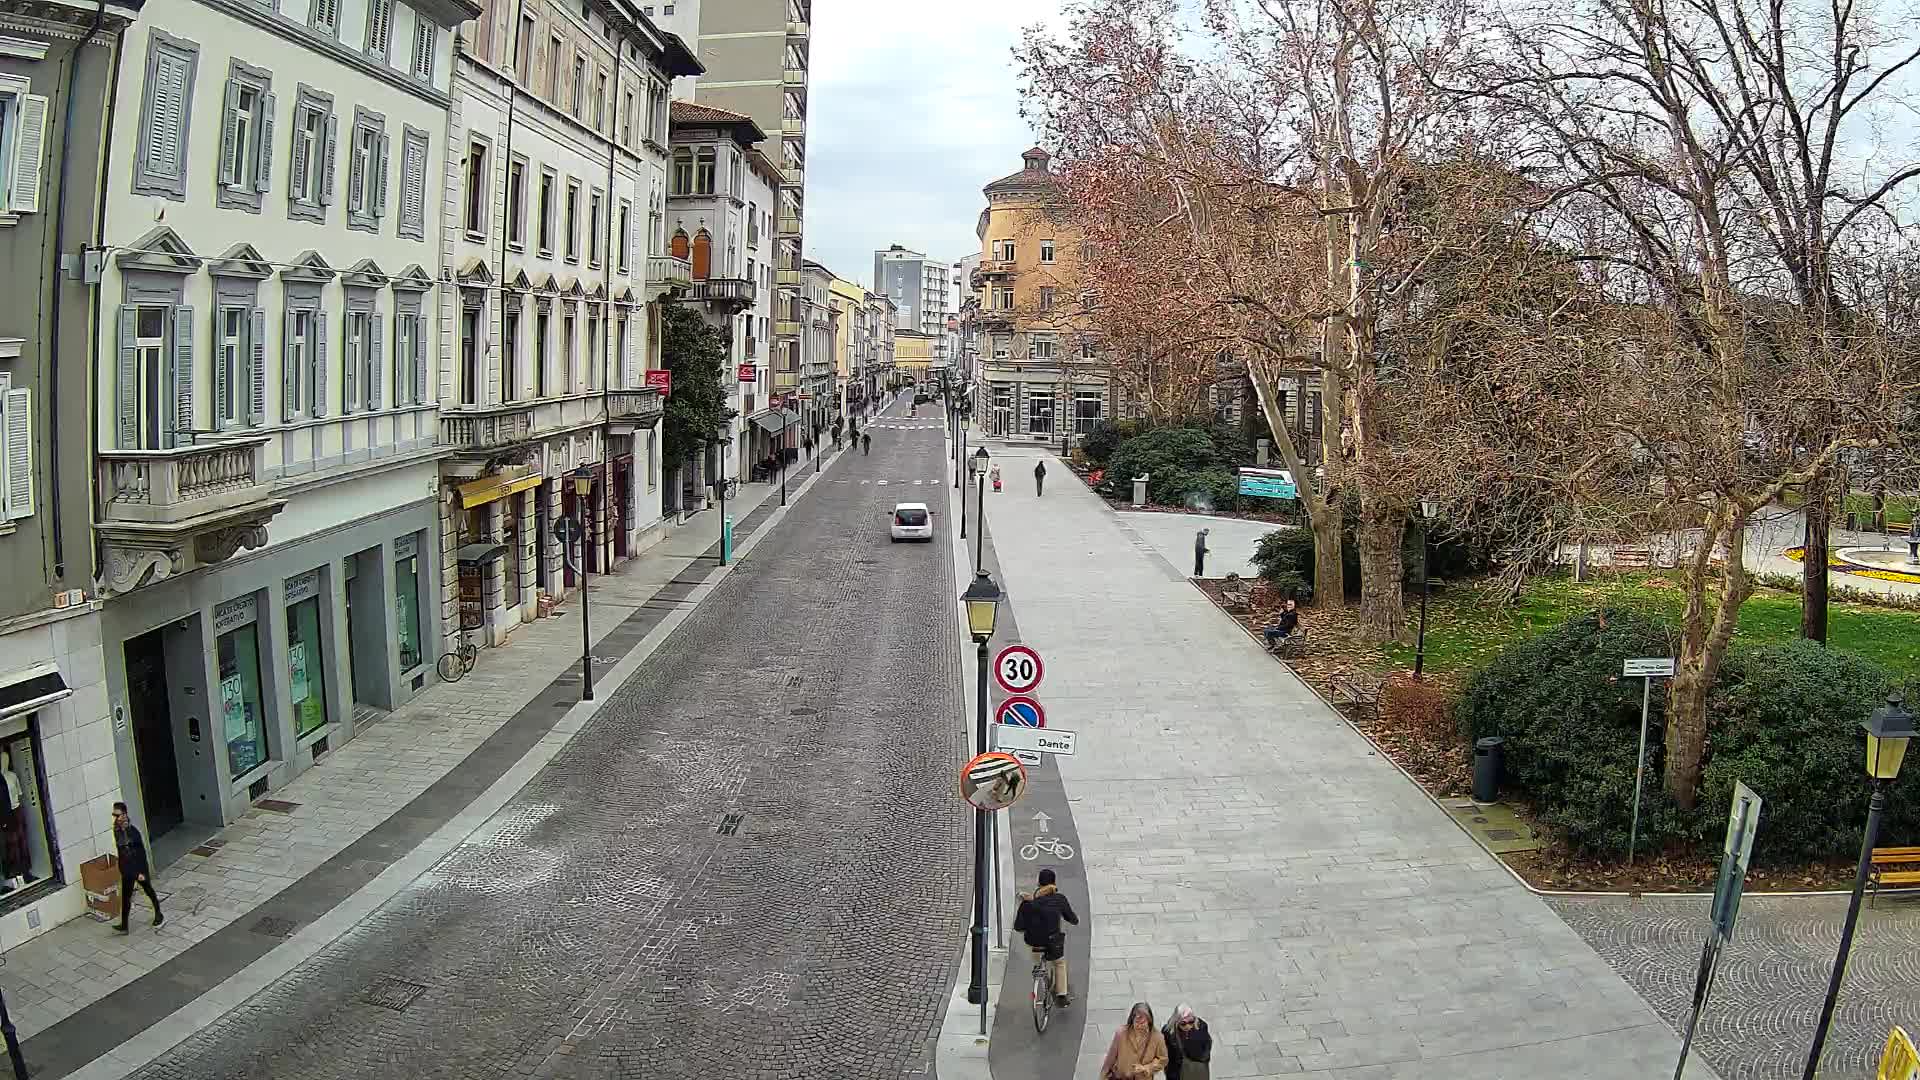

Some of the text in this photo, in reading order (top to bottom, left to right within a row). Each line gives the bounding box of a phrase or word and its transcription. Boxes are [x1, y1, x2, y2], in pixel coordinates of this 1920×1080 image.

[1006, 659, 1033, 680] 30
[223, 679, 241, 700] 130
[1039, 738, 1070, 749] Dante
